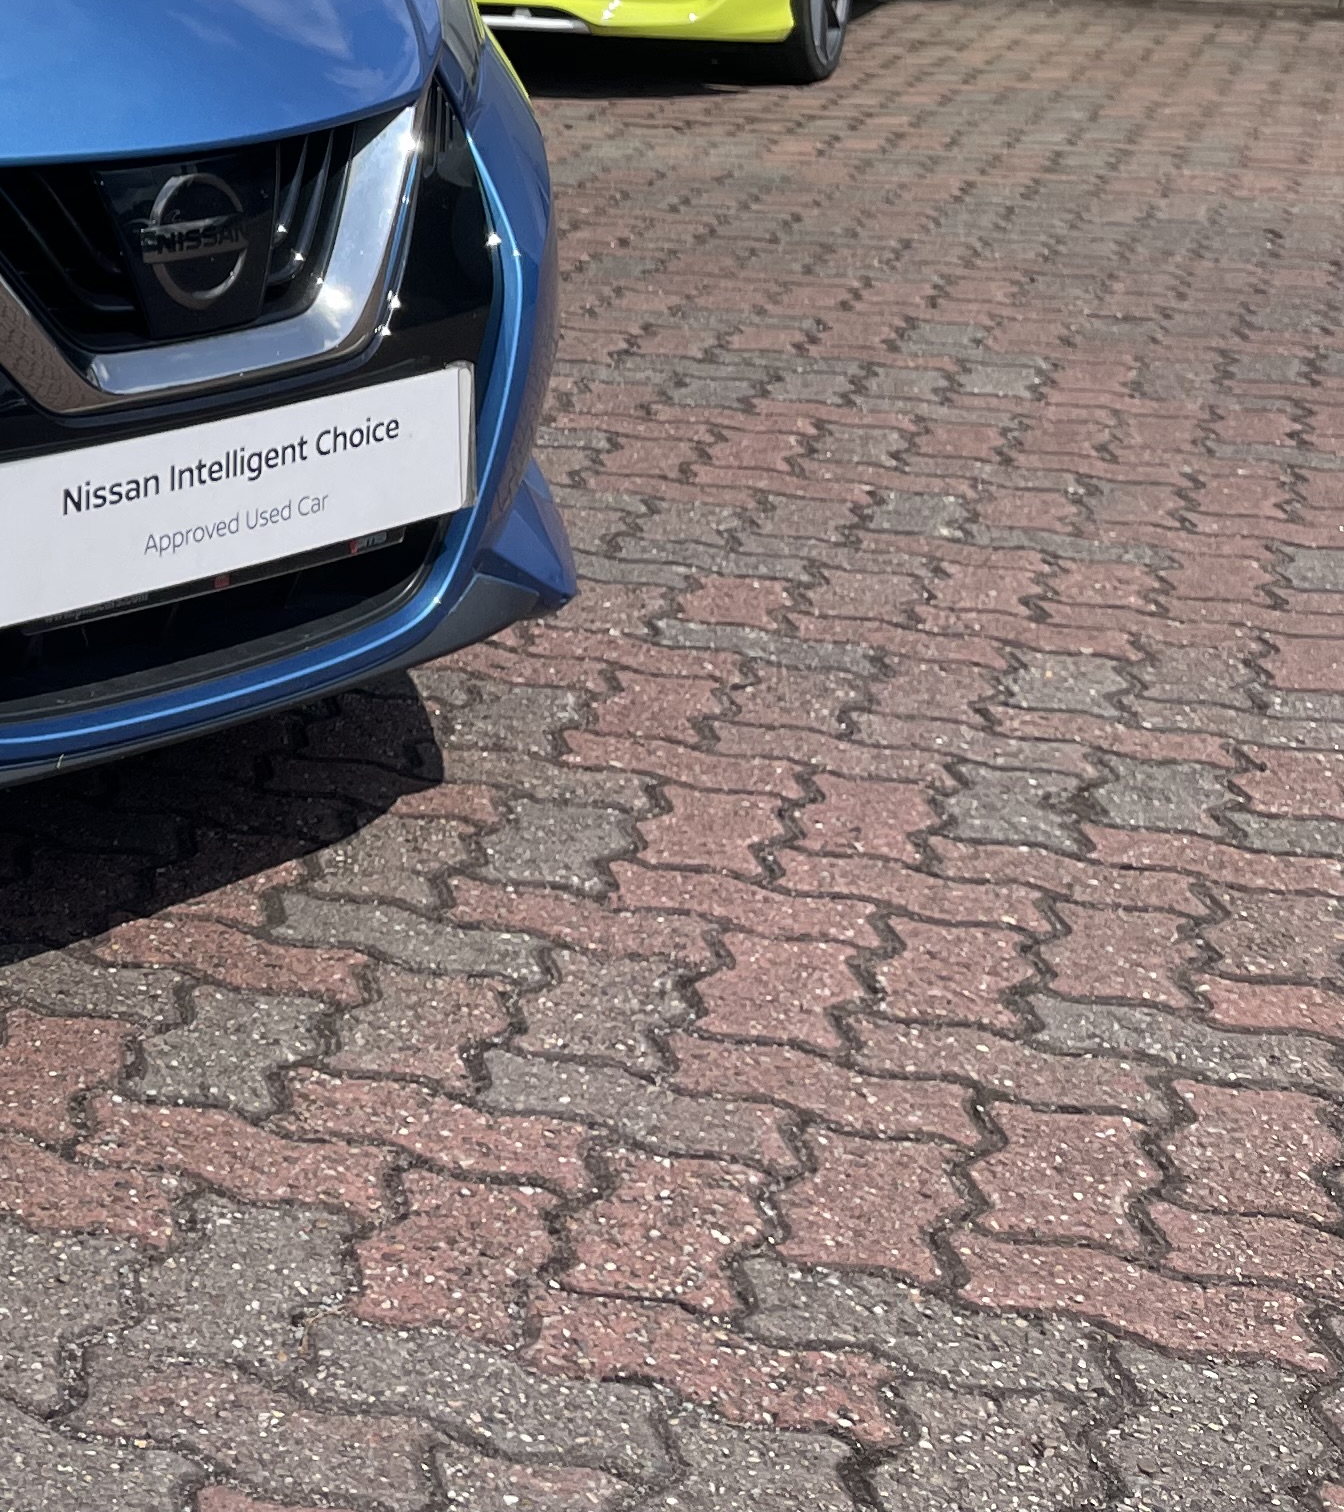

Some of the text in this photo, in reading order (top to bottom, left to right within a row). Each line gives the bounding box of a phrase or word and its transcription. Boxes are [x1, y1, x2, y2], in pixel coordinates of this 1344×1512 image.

[156, 222, 247, 256] NISSAN
[61, 416, 401, 517] Nissan Intelligent Choice
[143, 491, 330, 556] Approved Used Car
